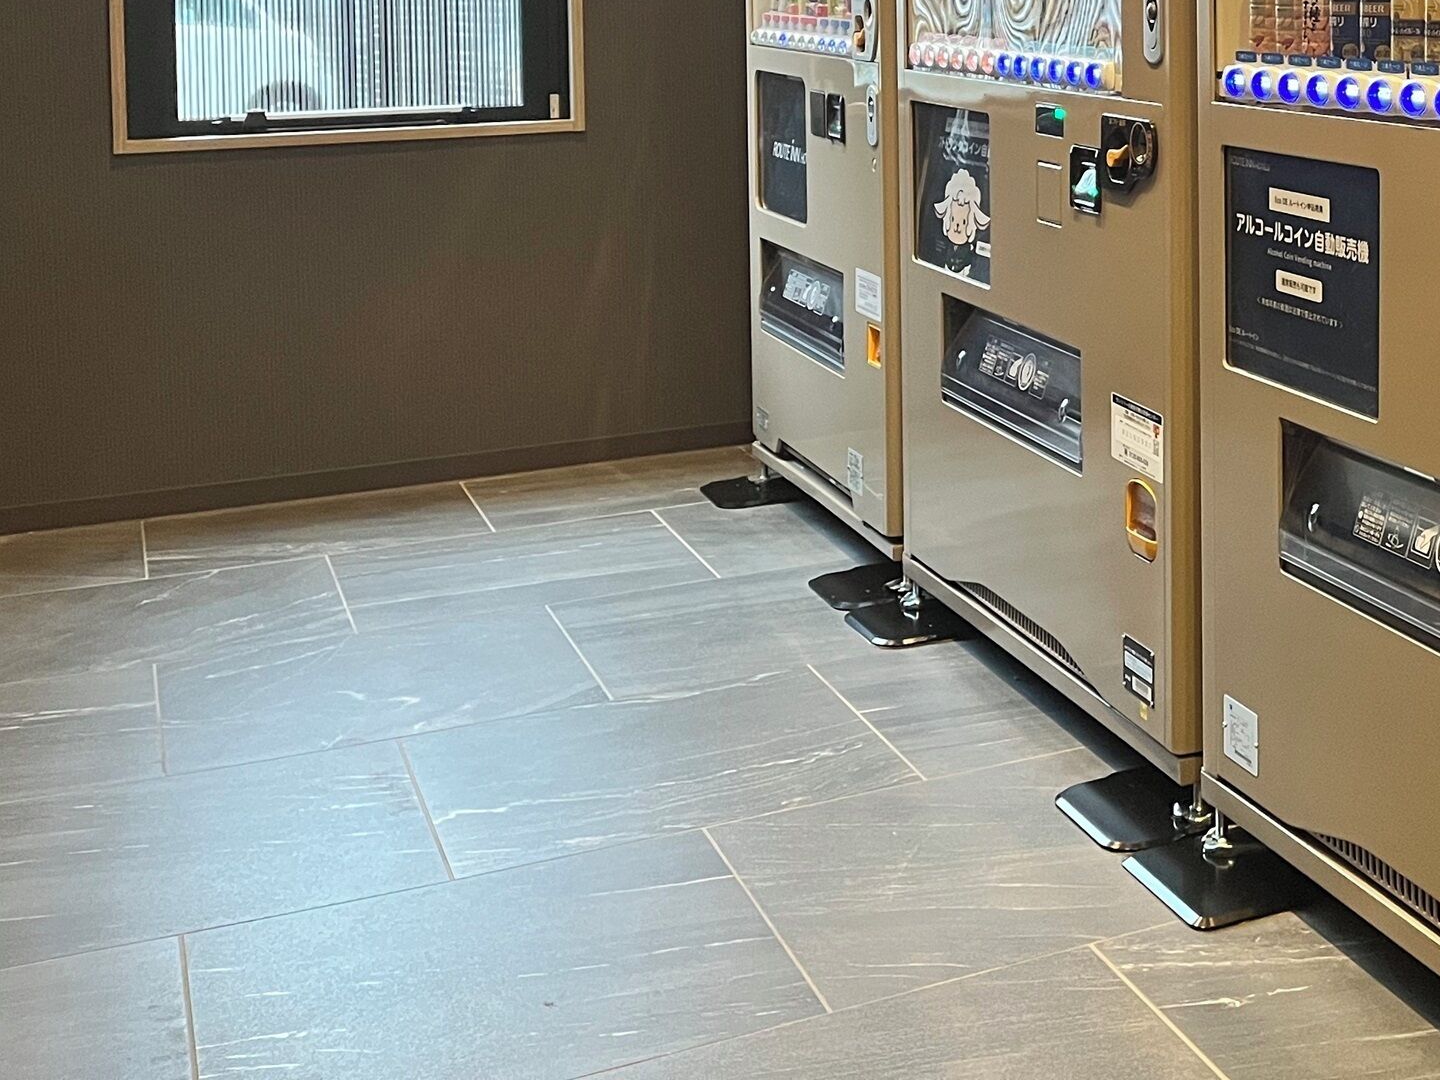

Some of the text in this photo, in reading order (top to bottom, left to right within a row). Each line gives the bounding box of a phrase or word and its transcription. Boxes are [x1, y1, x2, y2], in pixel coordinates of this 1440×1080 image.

[1235, 212, 1370, 265] アルコールコイン自動販売機
